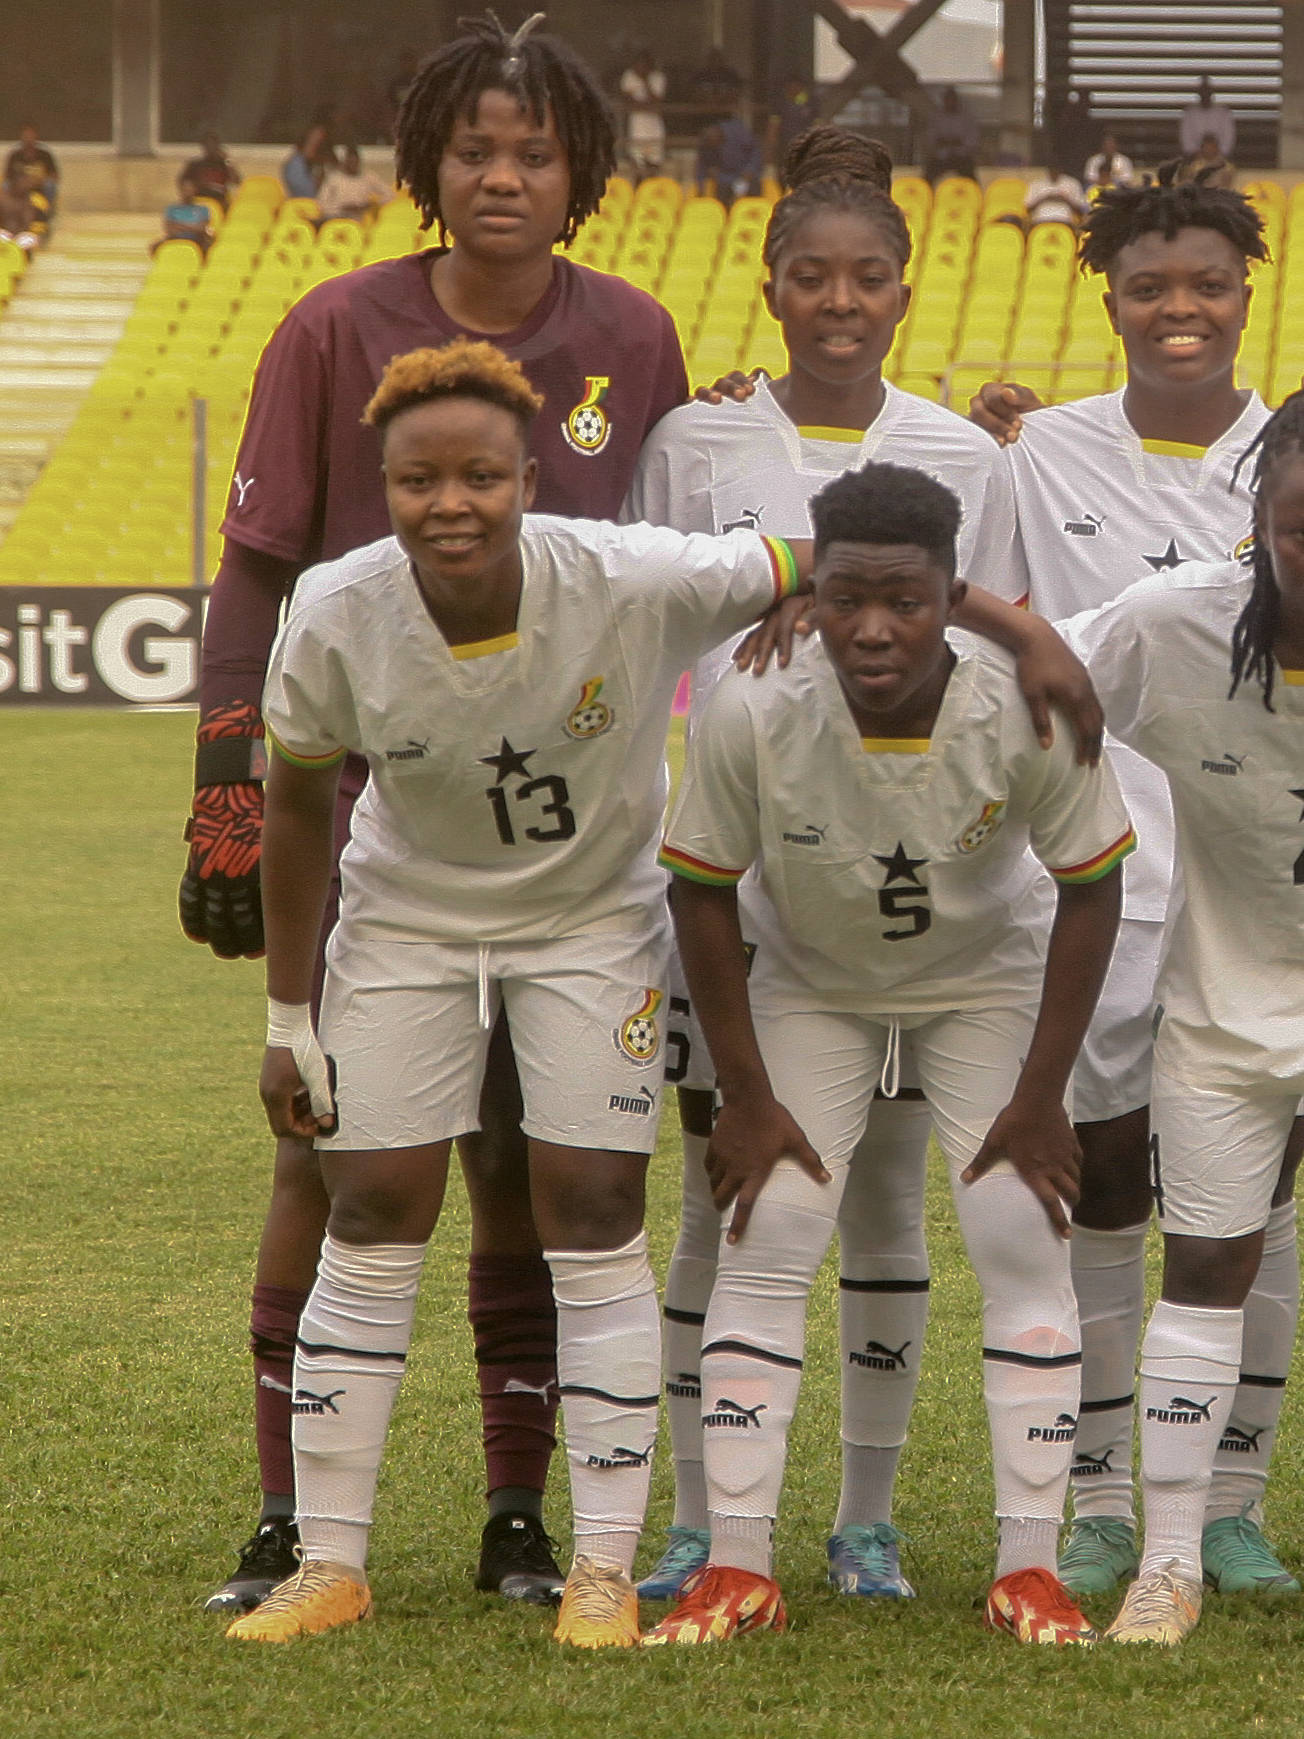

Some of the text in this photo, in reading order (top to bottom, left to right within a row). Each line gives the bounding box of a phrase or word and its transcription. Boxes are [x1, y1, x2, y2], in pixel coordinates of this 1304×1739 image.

[1202, 760, 1237, 776] PUMA
[486, 775, 576, 846] 13
[783, 831, 820, 846] PUMA
[878, 886, 931, 942] 5
[609, 1095, 650, 1115] PUMA
[849, 1352, 896, 1371] PUMA
[1146, 1408, 1202, 1424] PUMA
